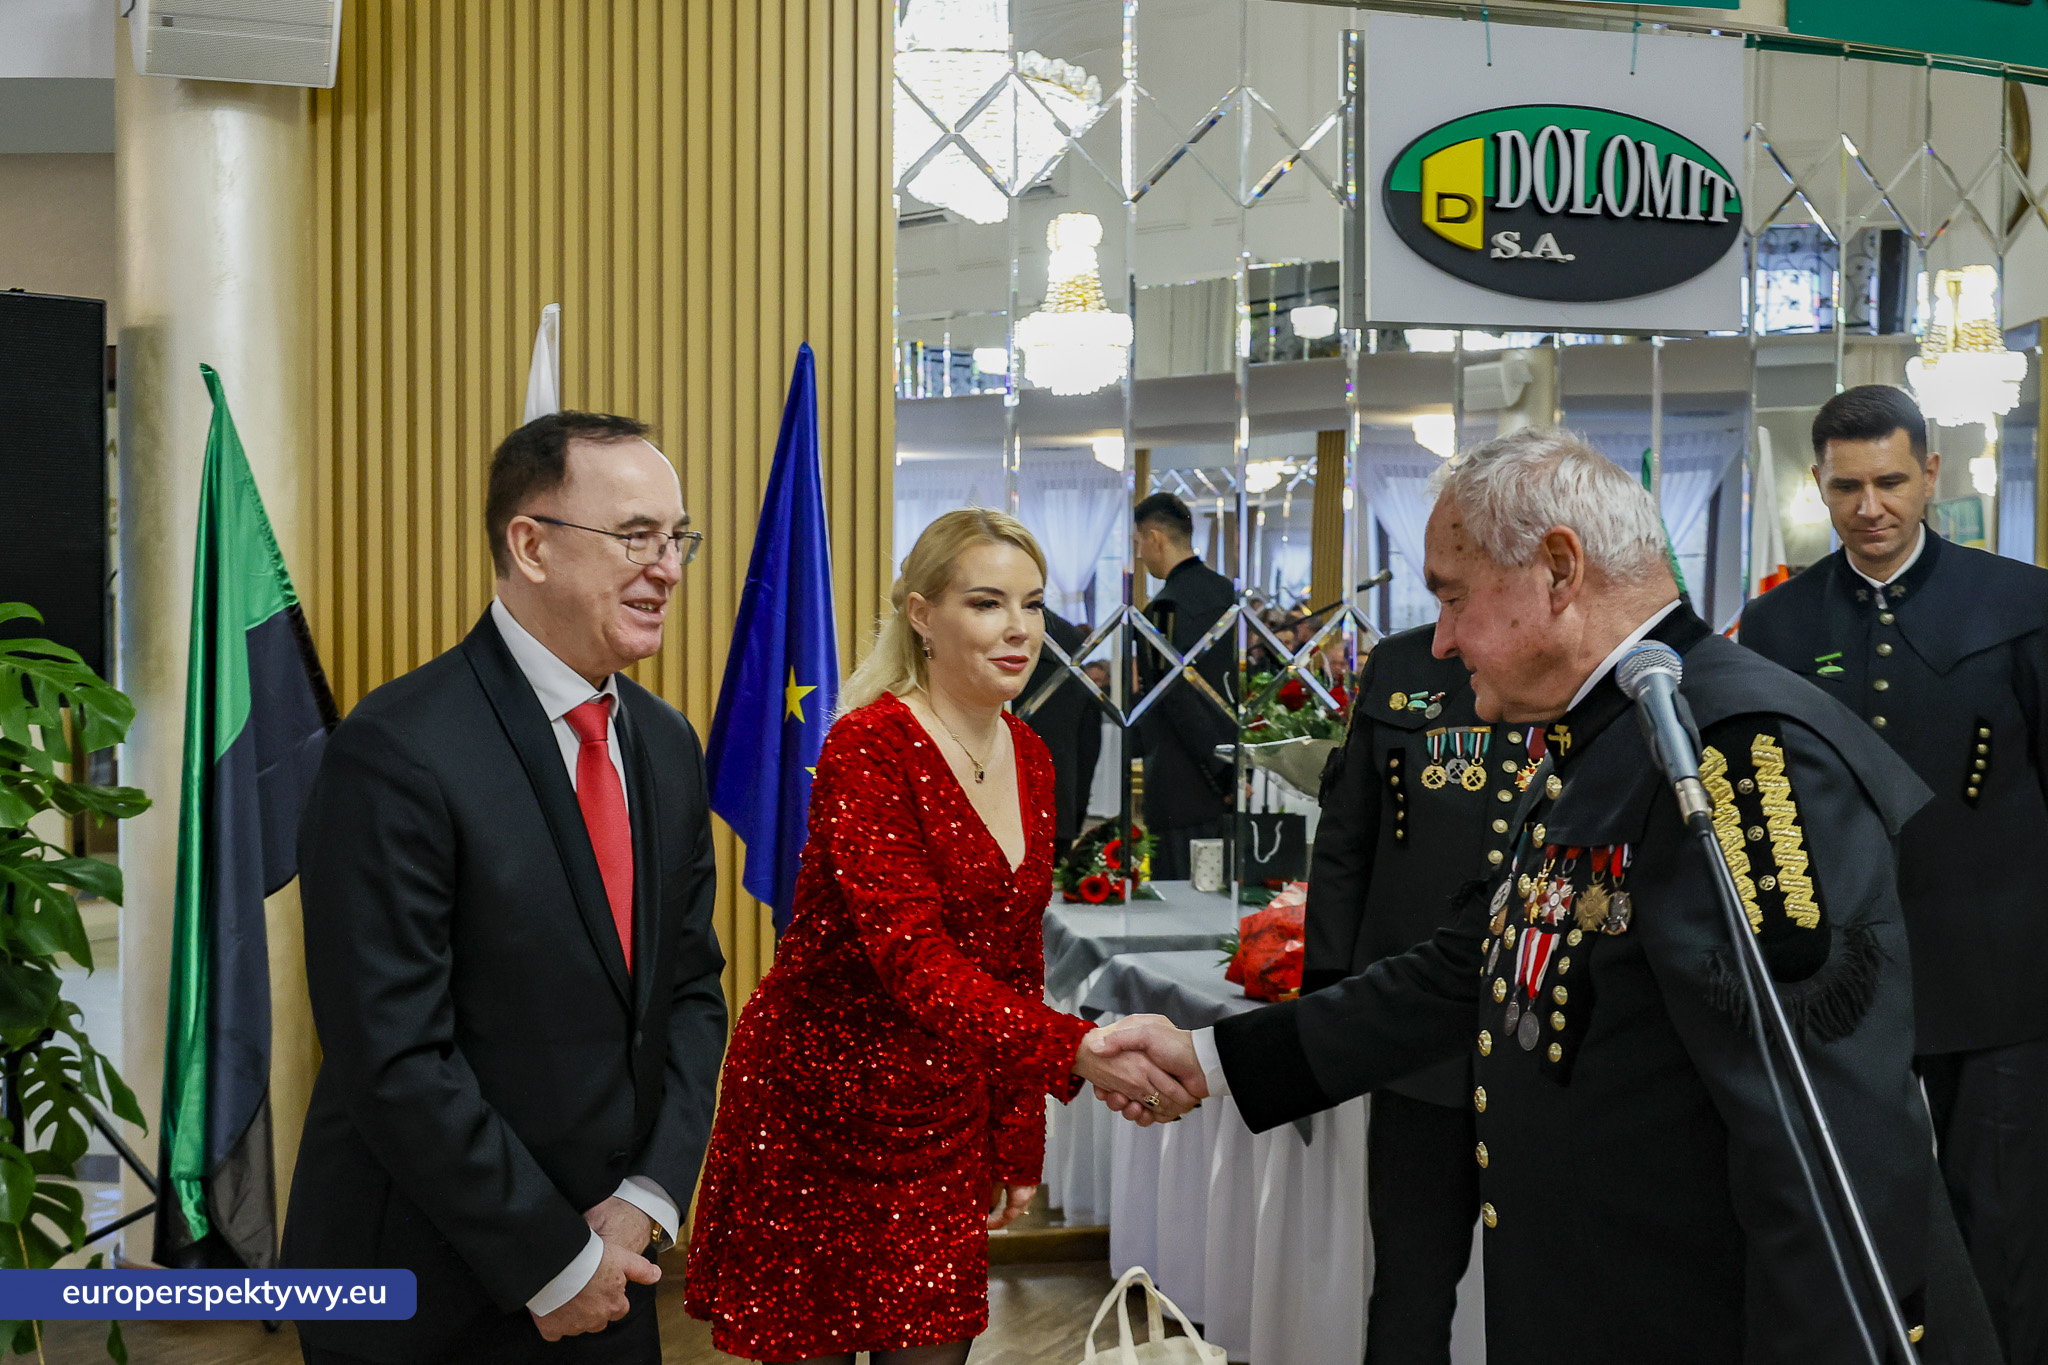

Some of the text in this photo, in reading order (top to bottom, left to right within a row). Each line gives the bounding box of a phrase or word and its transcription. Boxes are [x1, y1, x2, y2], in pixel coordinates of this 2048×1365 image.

[1495, 125, 1736, 223] DOLOMIT
[1437, 192, 1477, 224] D
[1490, 231, 1576, 262] S.A.
